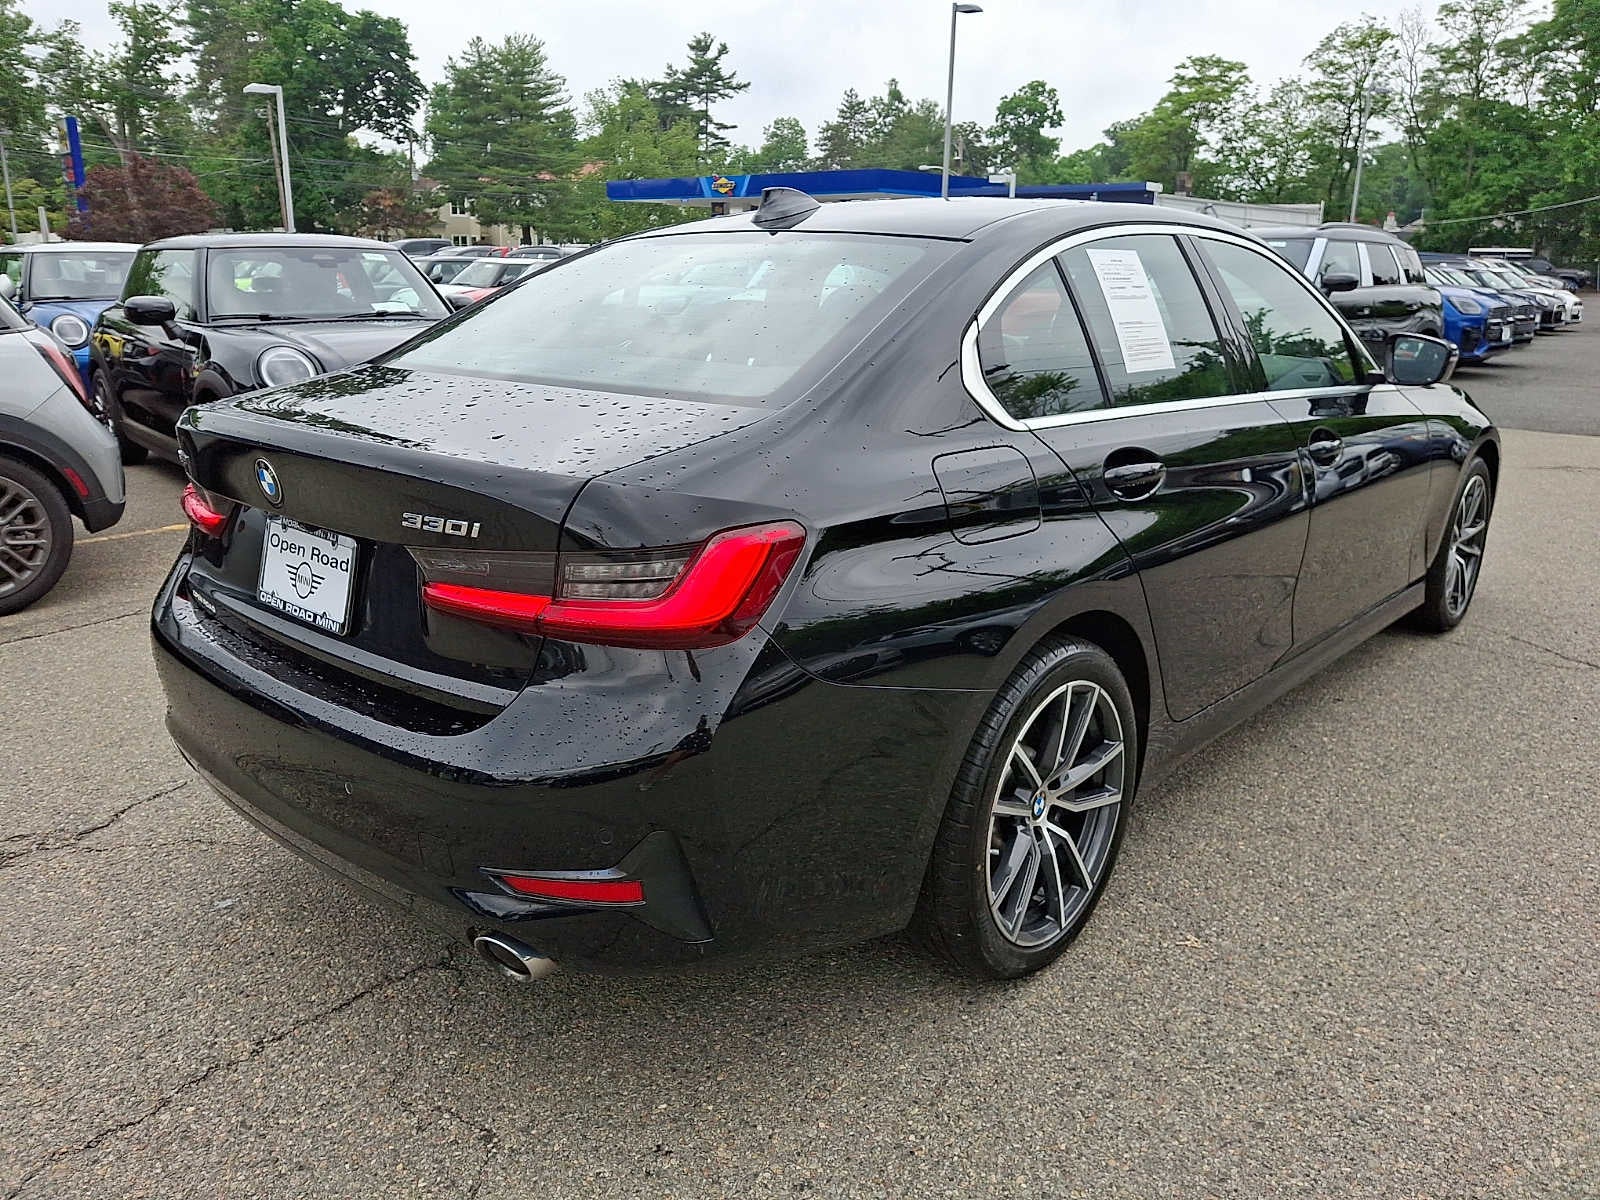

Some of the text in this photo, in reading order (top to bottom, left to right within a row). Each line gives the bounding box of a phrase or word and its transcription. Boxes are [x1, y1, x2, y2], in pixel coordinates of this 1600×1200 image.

[401, 512, 481, 538] 330i
[270, 533, 350, 573] Open Road
[260, 591, 341, 633] OPEN ROAD MINI
